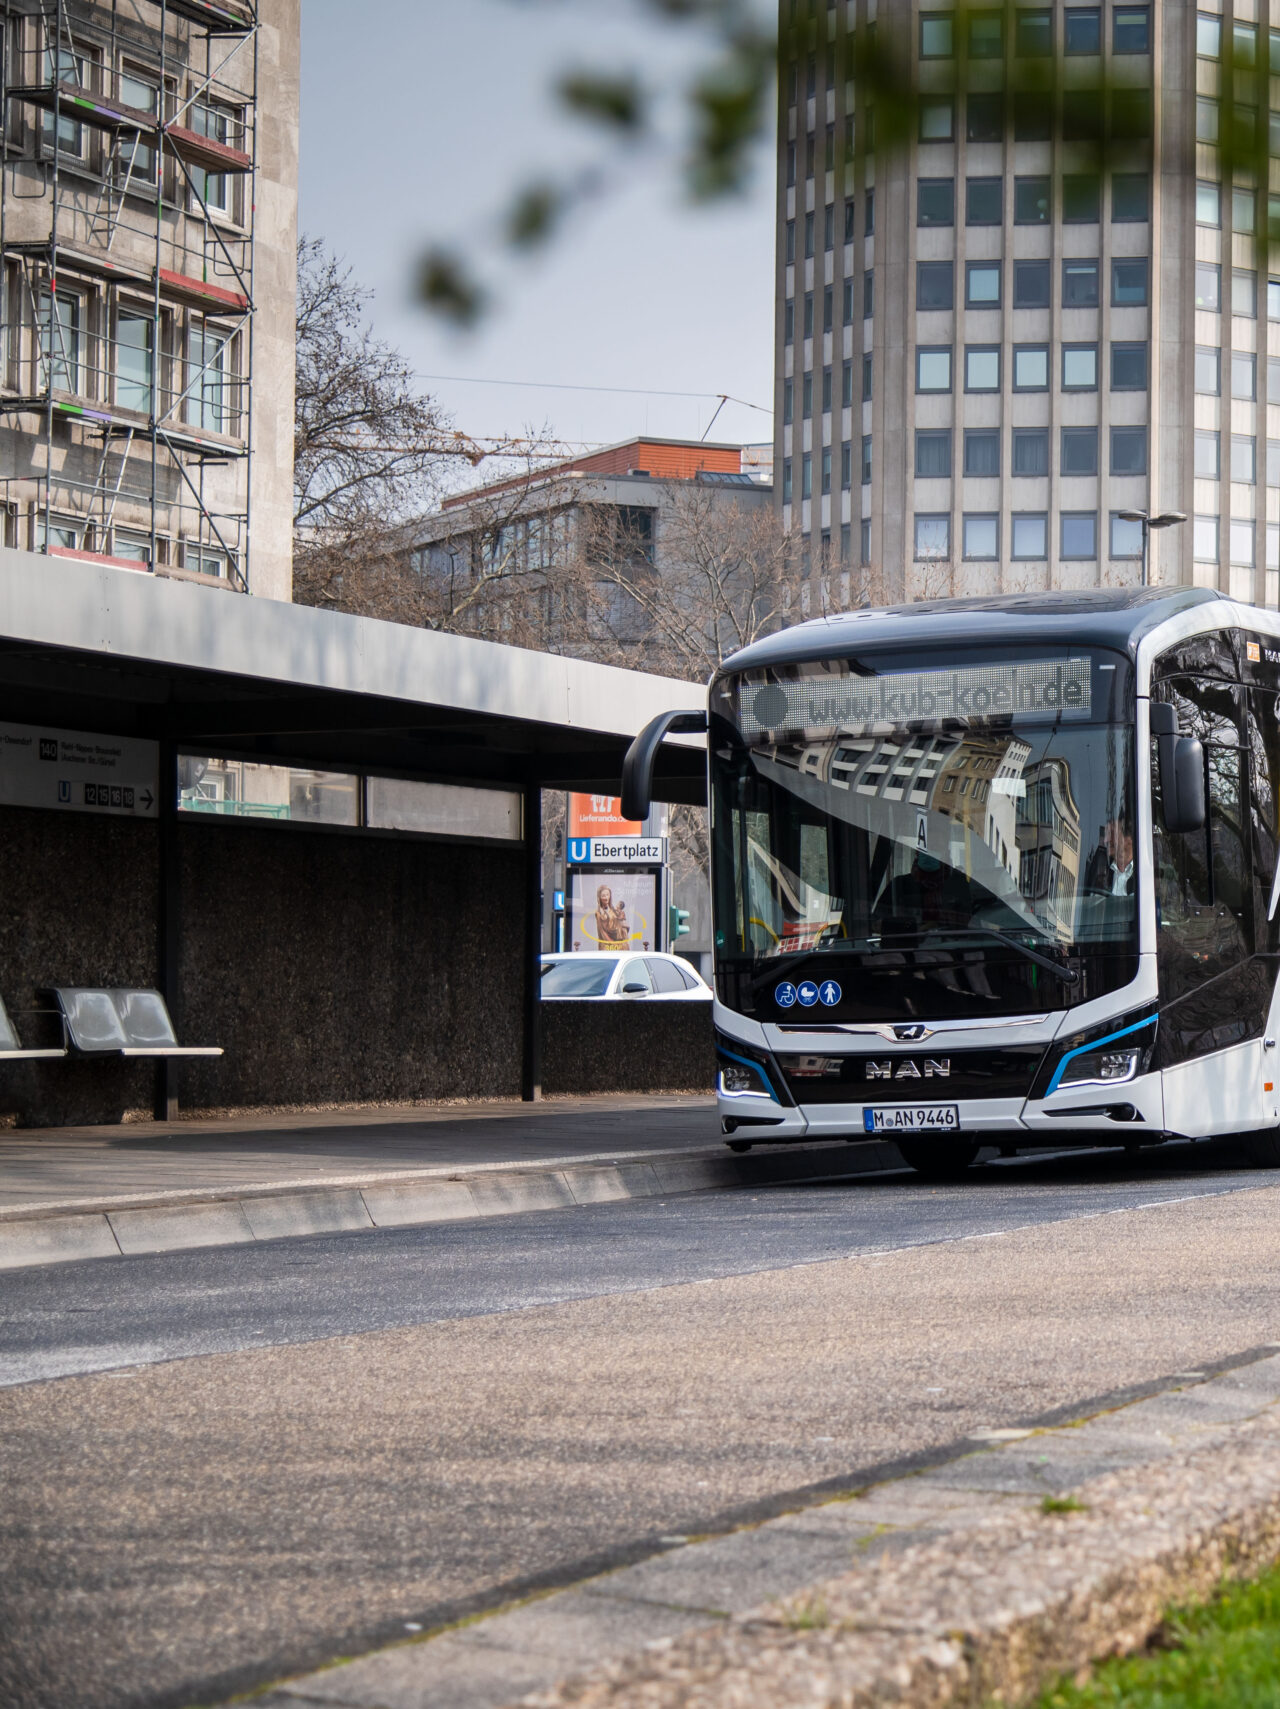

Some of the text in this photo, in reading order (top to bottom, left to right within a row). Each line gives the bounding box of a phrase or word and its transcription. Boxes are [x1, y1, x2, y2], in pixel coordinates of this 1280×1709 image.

[807, 665, 1083, 725] www.kvb-koeln.de
[40, 742, 57, 758] 140
[86, 787, 96, 801] 12
[98, 789, 109, 802] 15
[111, 790, 121, 804] 16
[124, 791, 134, 805] 18
[571, 841, 658, 861] U Ebertplatz
[866, 1059, 950, 1079] MAN
[874, 1109, 954, 1127] M AN 9446
